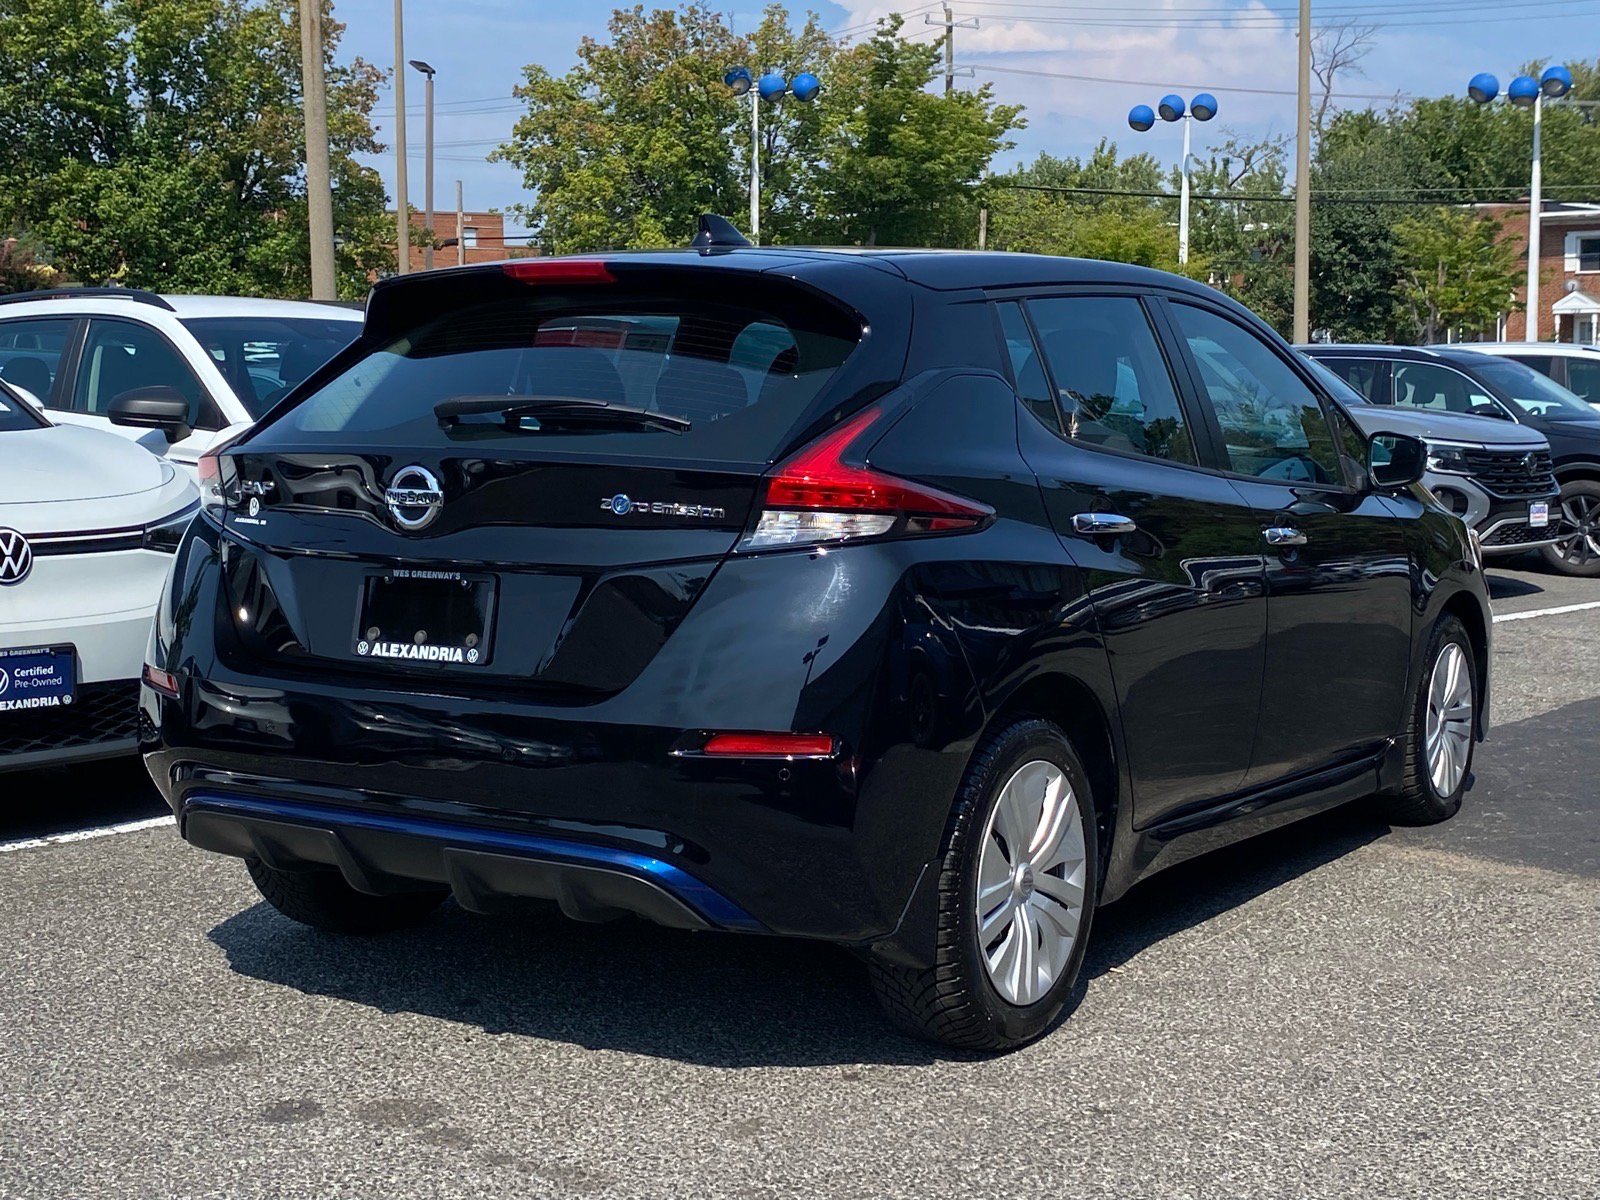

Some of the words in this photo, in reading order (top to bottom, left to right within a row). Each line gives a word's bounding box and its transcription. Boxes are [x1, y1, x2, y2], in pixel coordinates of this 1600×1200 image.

[386, 490, 441, 503] NISSAN
[411, 570, 461, 580] GREENWAY'S
[371, 642, 463, 662] ALEXANDRIA
[14, 665, 54, 677] Certified
[14, 676, 63, 689] Pre-Owned
[0, 696, 60, 711] EXANDRIA
